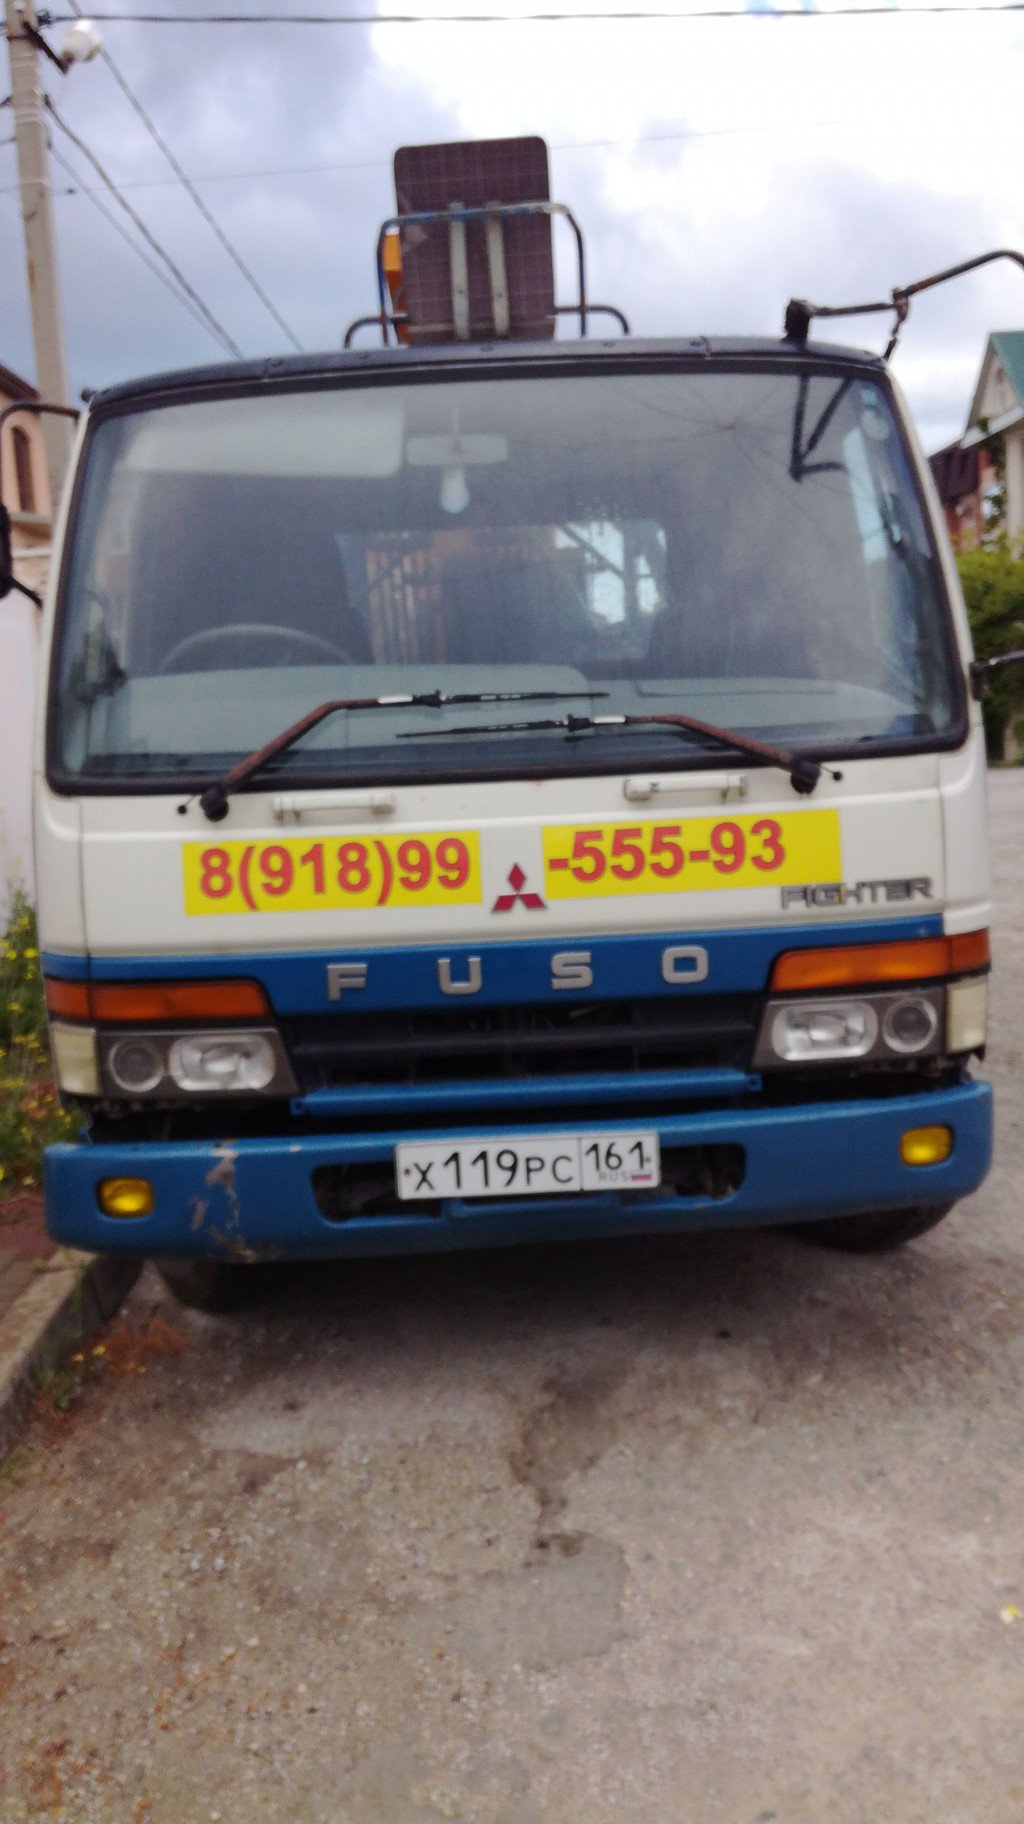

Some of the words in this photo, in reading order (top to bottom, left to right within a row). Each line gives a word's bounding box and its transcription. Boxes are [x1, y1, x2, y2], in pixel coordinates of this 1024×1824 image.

[200, 838, 471, 911] 8(918)99
[548, 819, 786, 883] -555-93
[781, 877, 933, 909] FIGHTER
[326, 945, 709, 1001] FUSO
[599, 1171, 630, 1182] RUS
